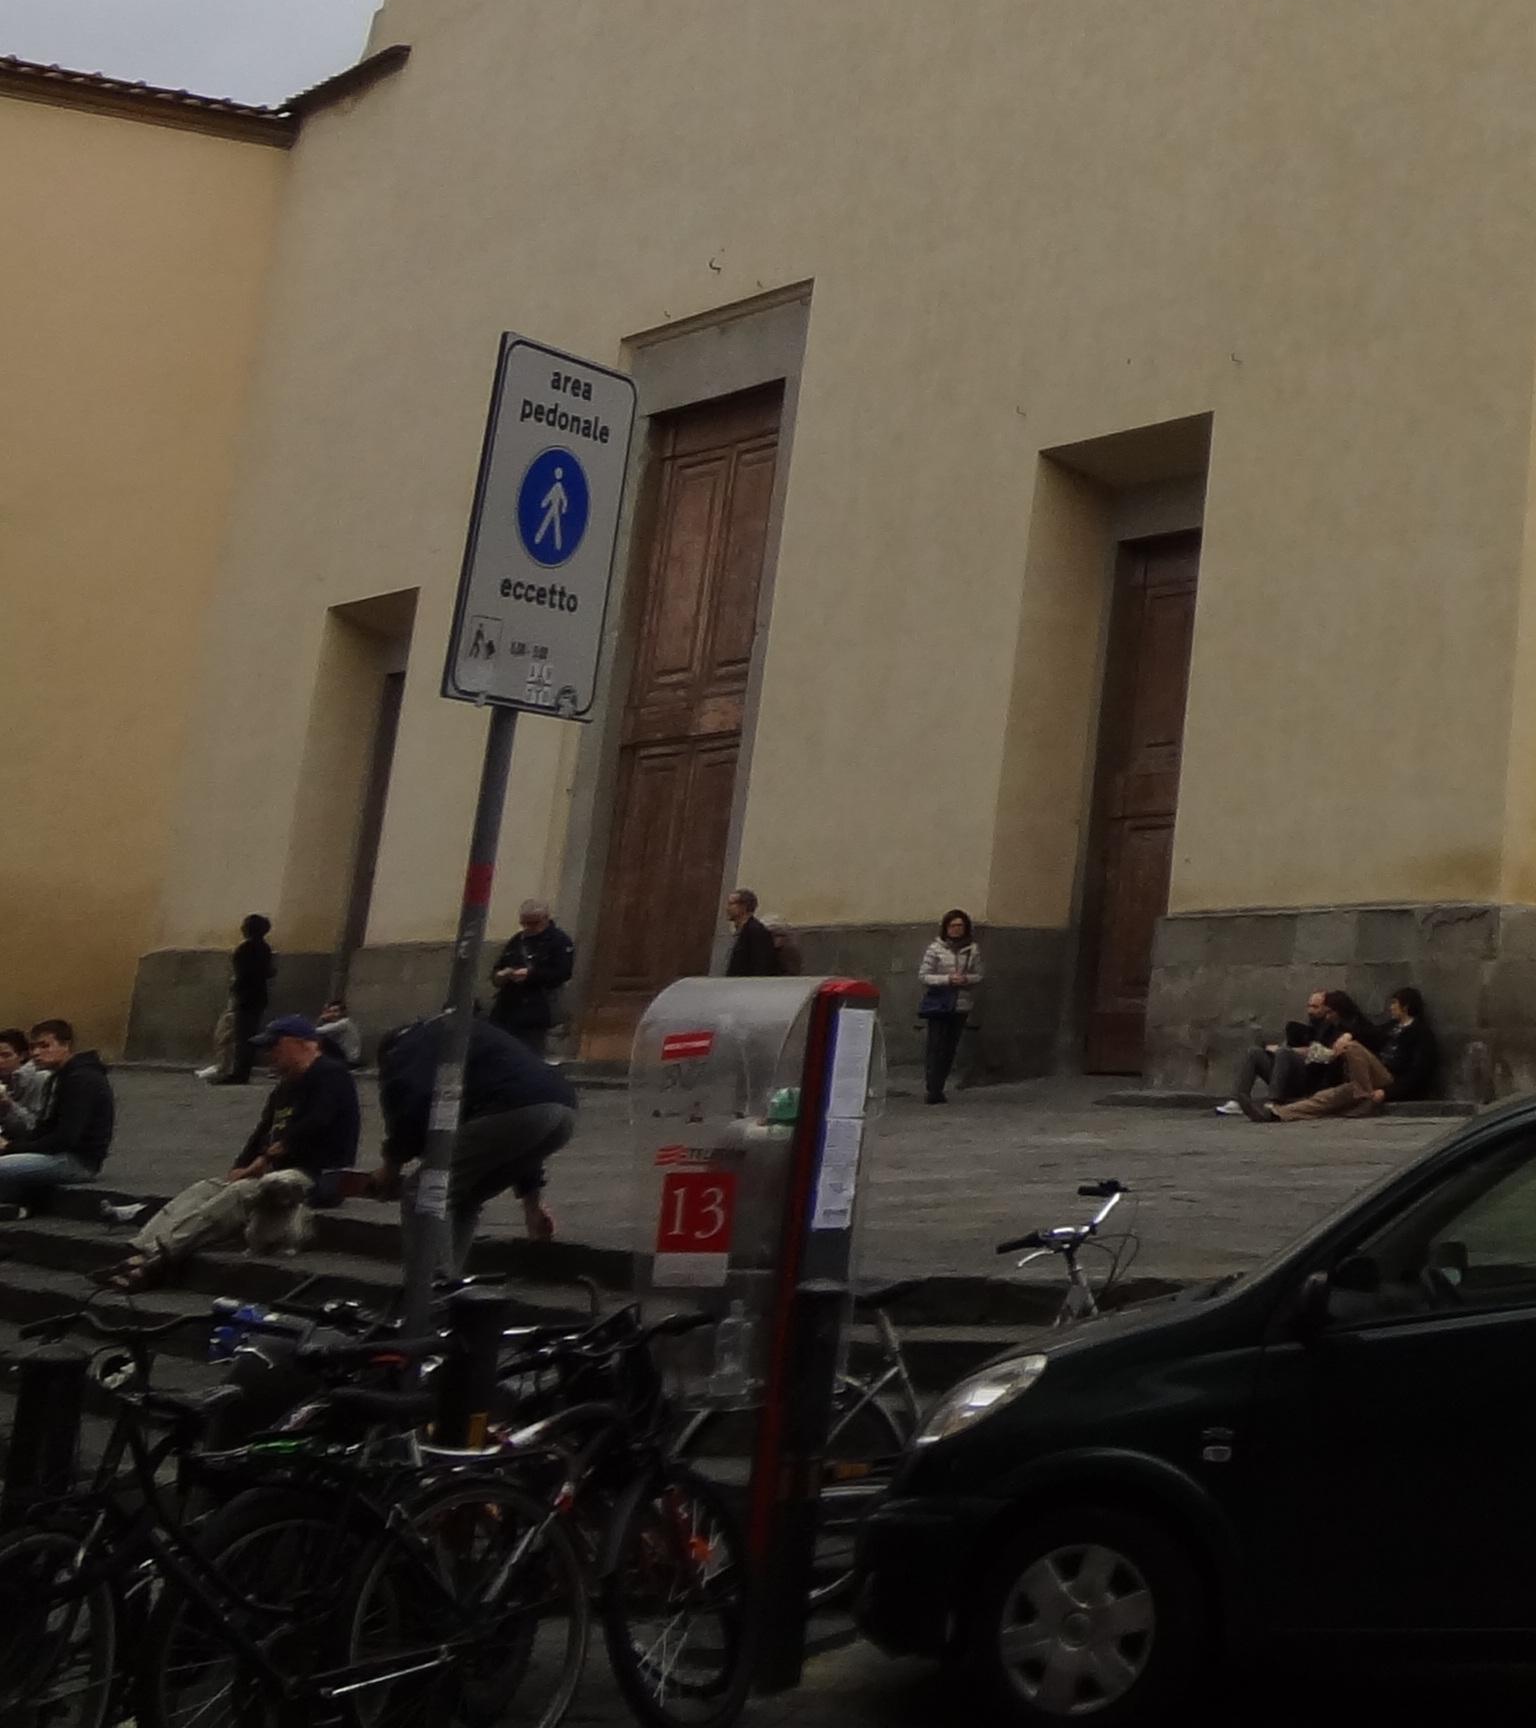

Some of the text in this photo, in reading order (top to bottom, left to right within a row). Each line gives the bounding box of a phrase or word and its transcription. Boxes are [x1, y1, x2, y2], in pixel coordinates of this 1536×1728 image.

[551, 372, 592, 401] area
[520, 399, 609, 443] pedonale
[500, 578, 577, 612] eccetto
[665, 1186, 726, 1240] 13
